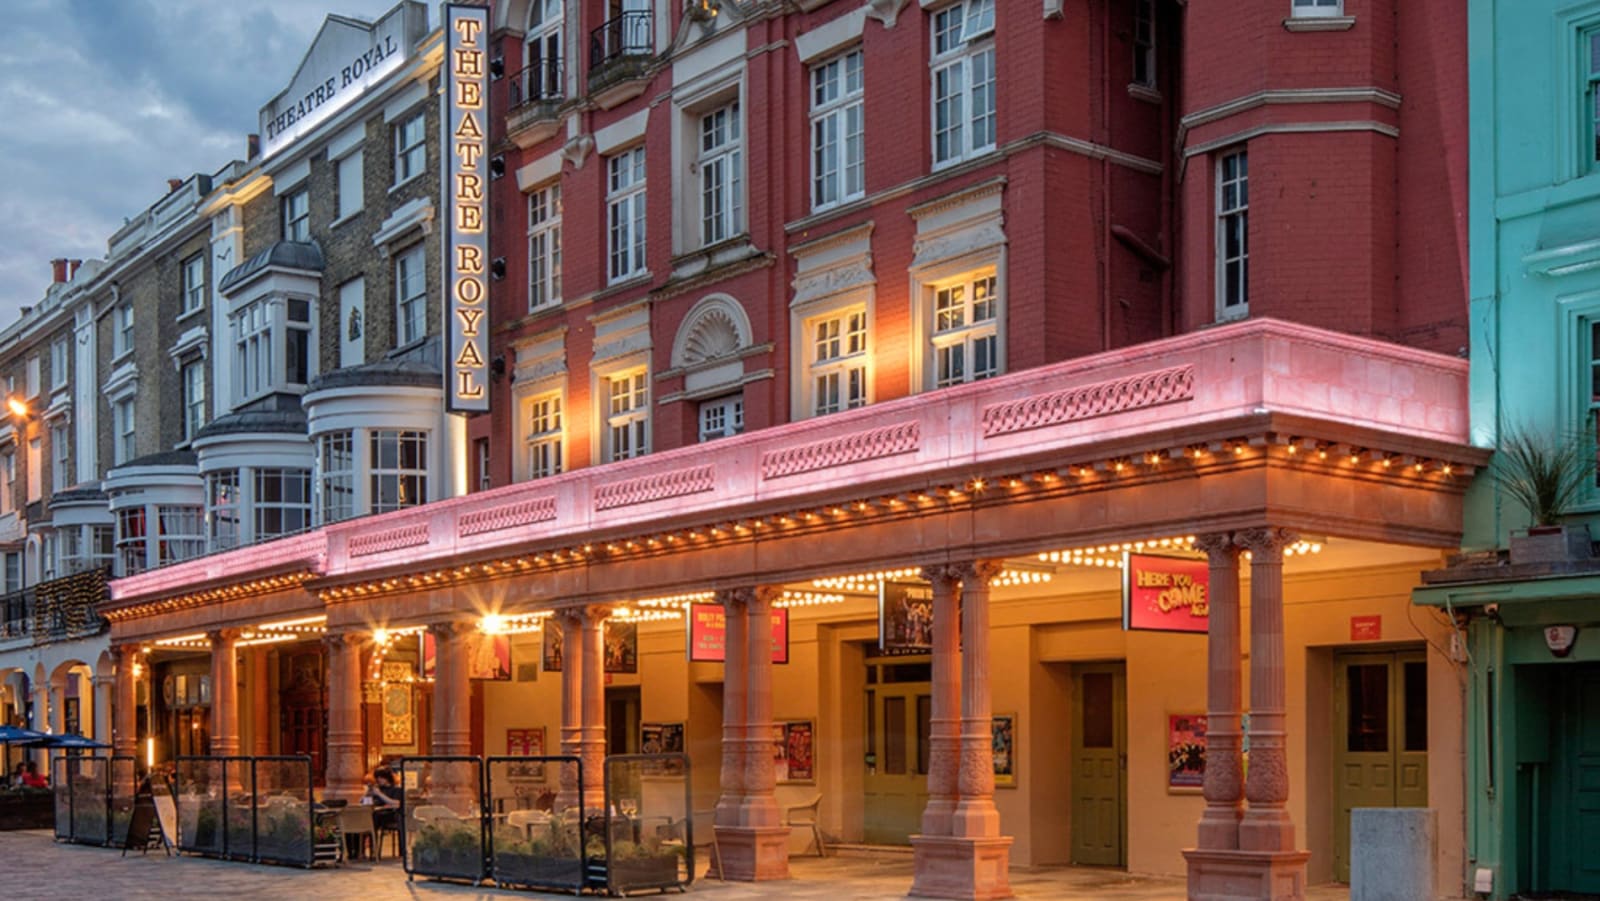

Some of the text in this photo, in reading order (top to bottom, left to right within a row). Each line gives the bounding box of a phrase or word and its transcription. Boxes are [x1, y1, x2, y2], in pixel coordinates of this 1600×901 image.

[266, 35, 398, 141] THEATRE ROYAL
[455, 18, 483, 397] THEATRE ROYAL
[1136, 568, 1193, 588] HERE YOU
[1158, 583, 1206, 613] COME
